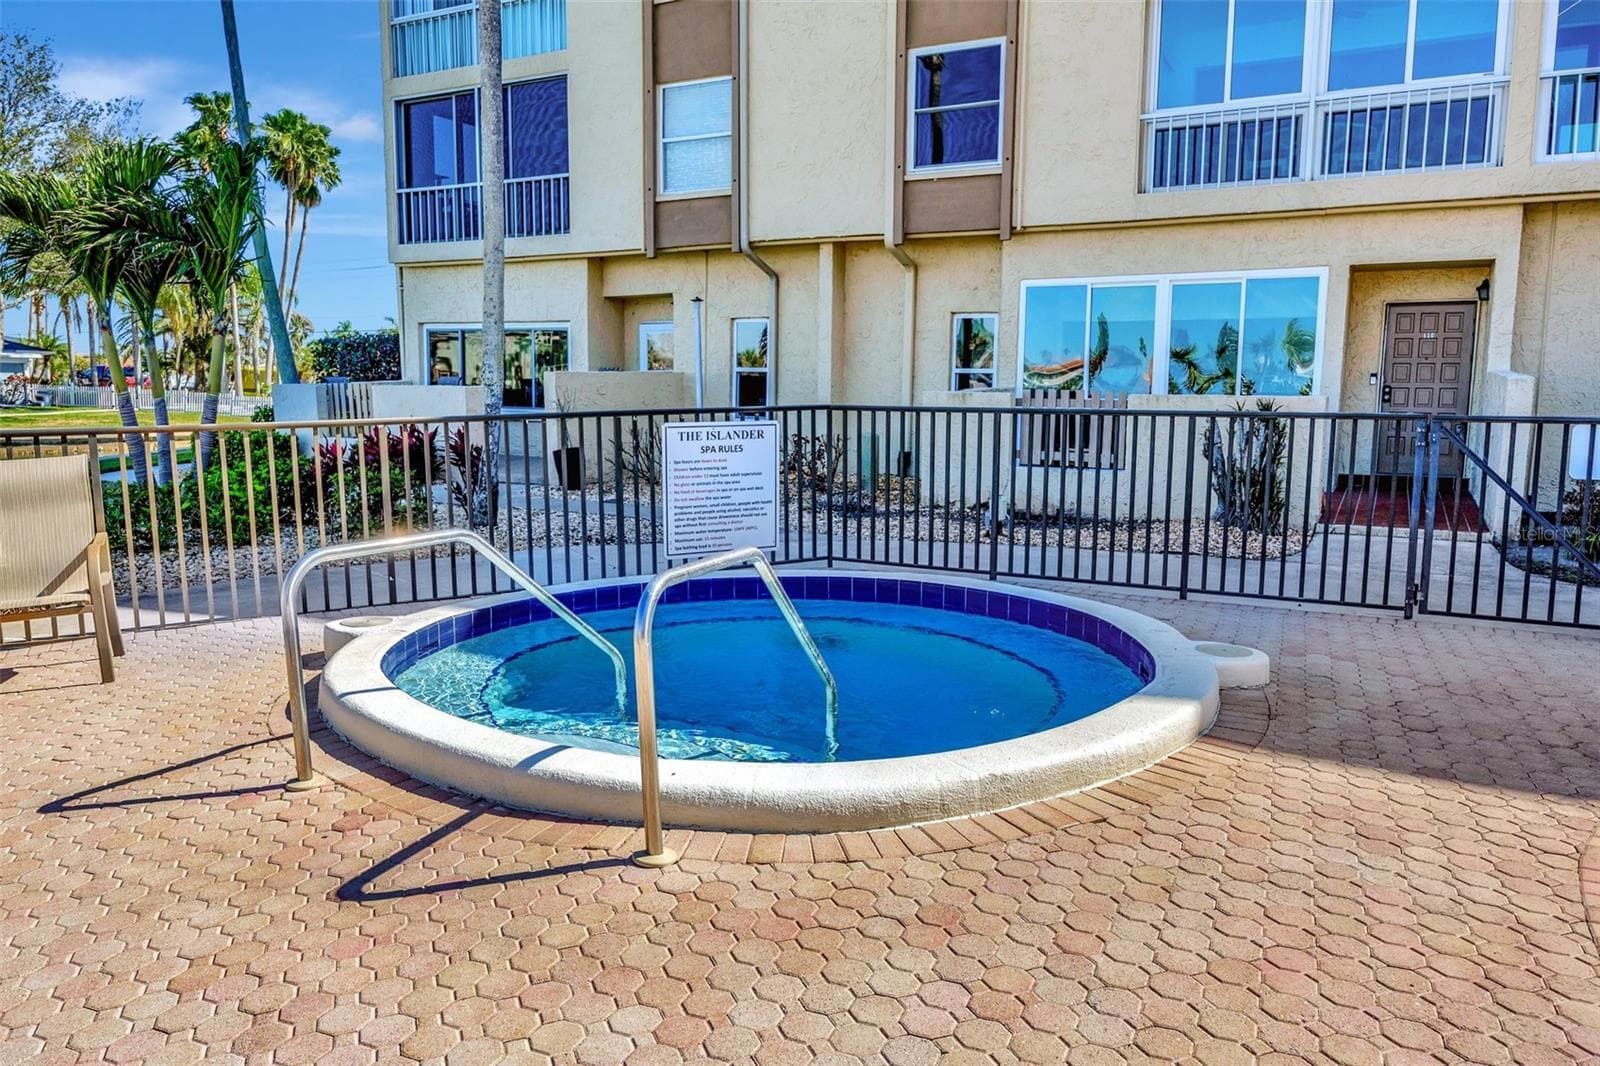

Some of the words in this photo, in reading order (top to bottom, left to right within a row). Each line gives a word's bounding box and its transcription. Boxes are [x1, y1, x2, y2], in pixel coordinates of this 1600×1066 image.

[678, 432, 702, 442] THE
[706, 430, 765, 440] ISLANDER
[700, 446, 716, 454] SPA
[719, 445, 743, 453] RULES
